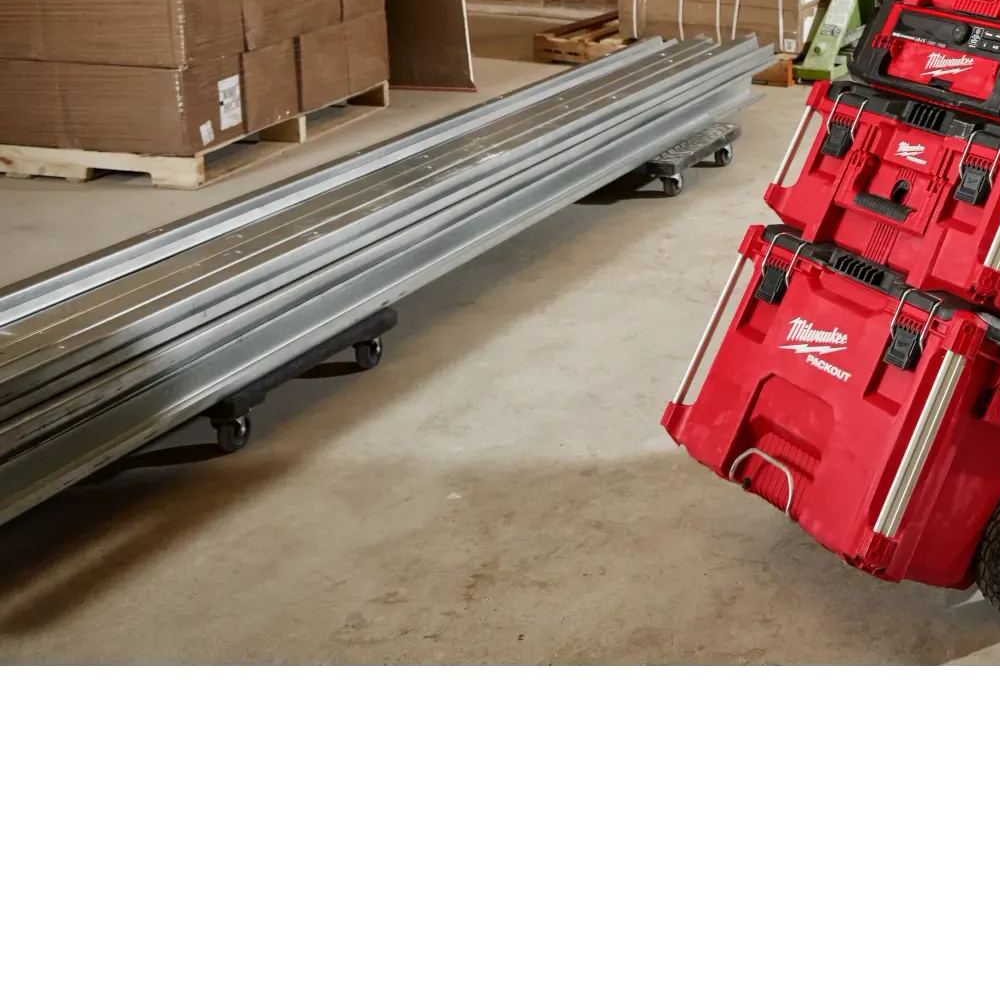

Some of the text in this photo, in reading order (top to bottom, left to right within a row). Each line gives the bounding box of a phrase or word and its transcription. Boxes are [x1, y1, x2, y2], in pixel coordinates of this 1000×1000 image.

[924, 51, 974, 70] Milwaukee
[786, 316, 848, 345] Milwaukee
[805, 353, 851, 382] PACKOUT
